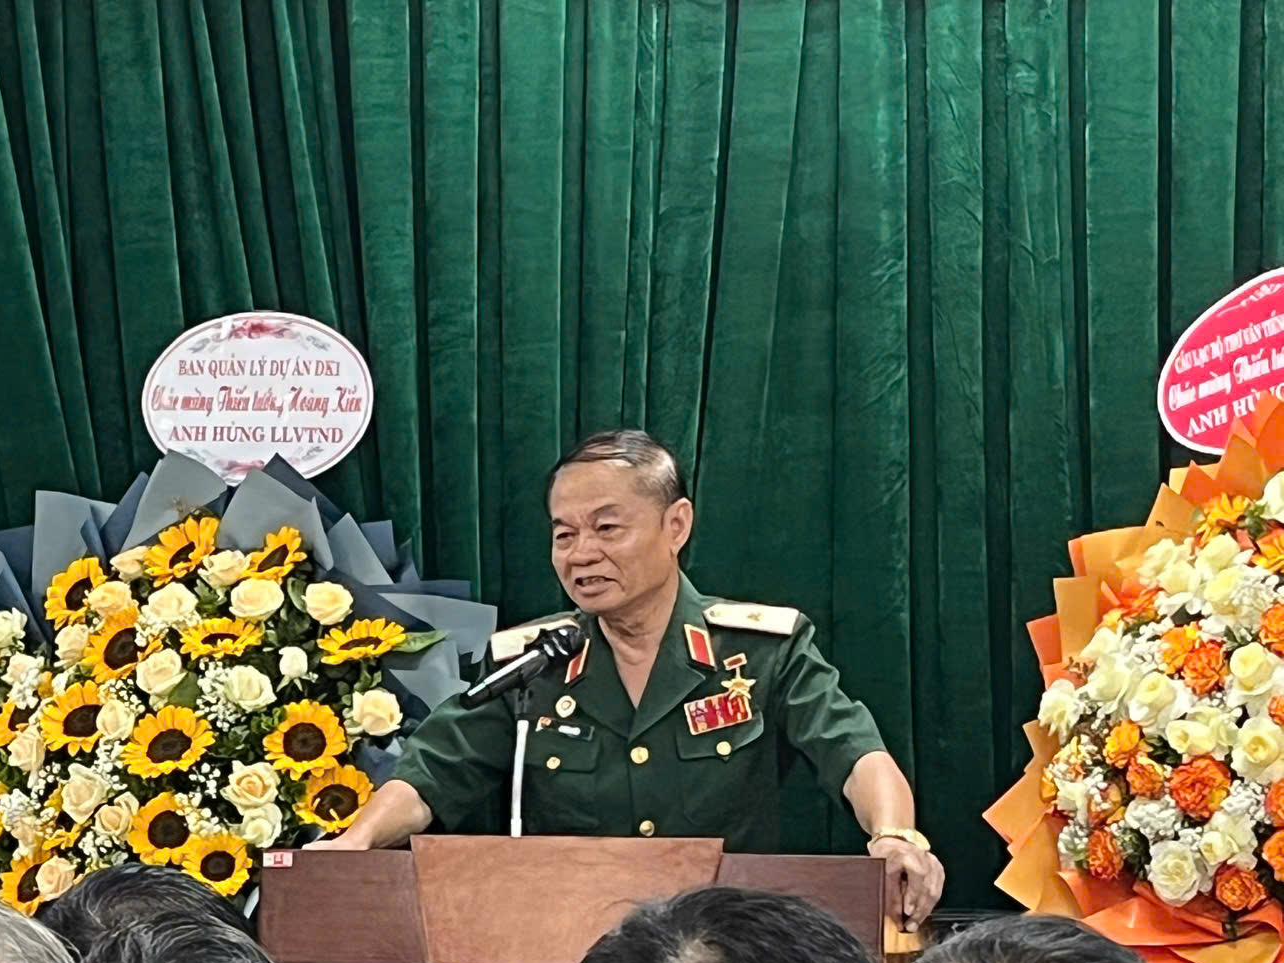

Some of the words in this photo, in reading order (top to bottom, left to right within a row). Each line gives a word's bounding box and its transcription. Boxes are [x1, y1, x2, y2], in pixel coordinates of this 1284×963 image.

[178, 359, 205, 376] BAN
[169, 425, 207, 442] ANH
[271, 426, 344, 444] LLVTND
